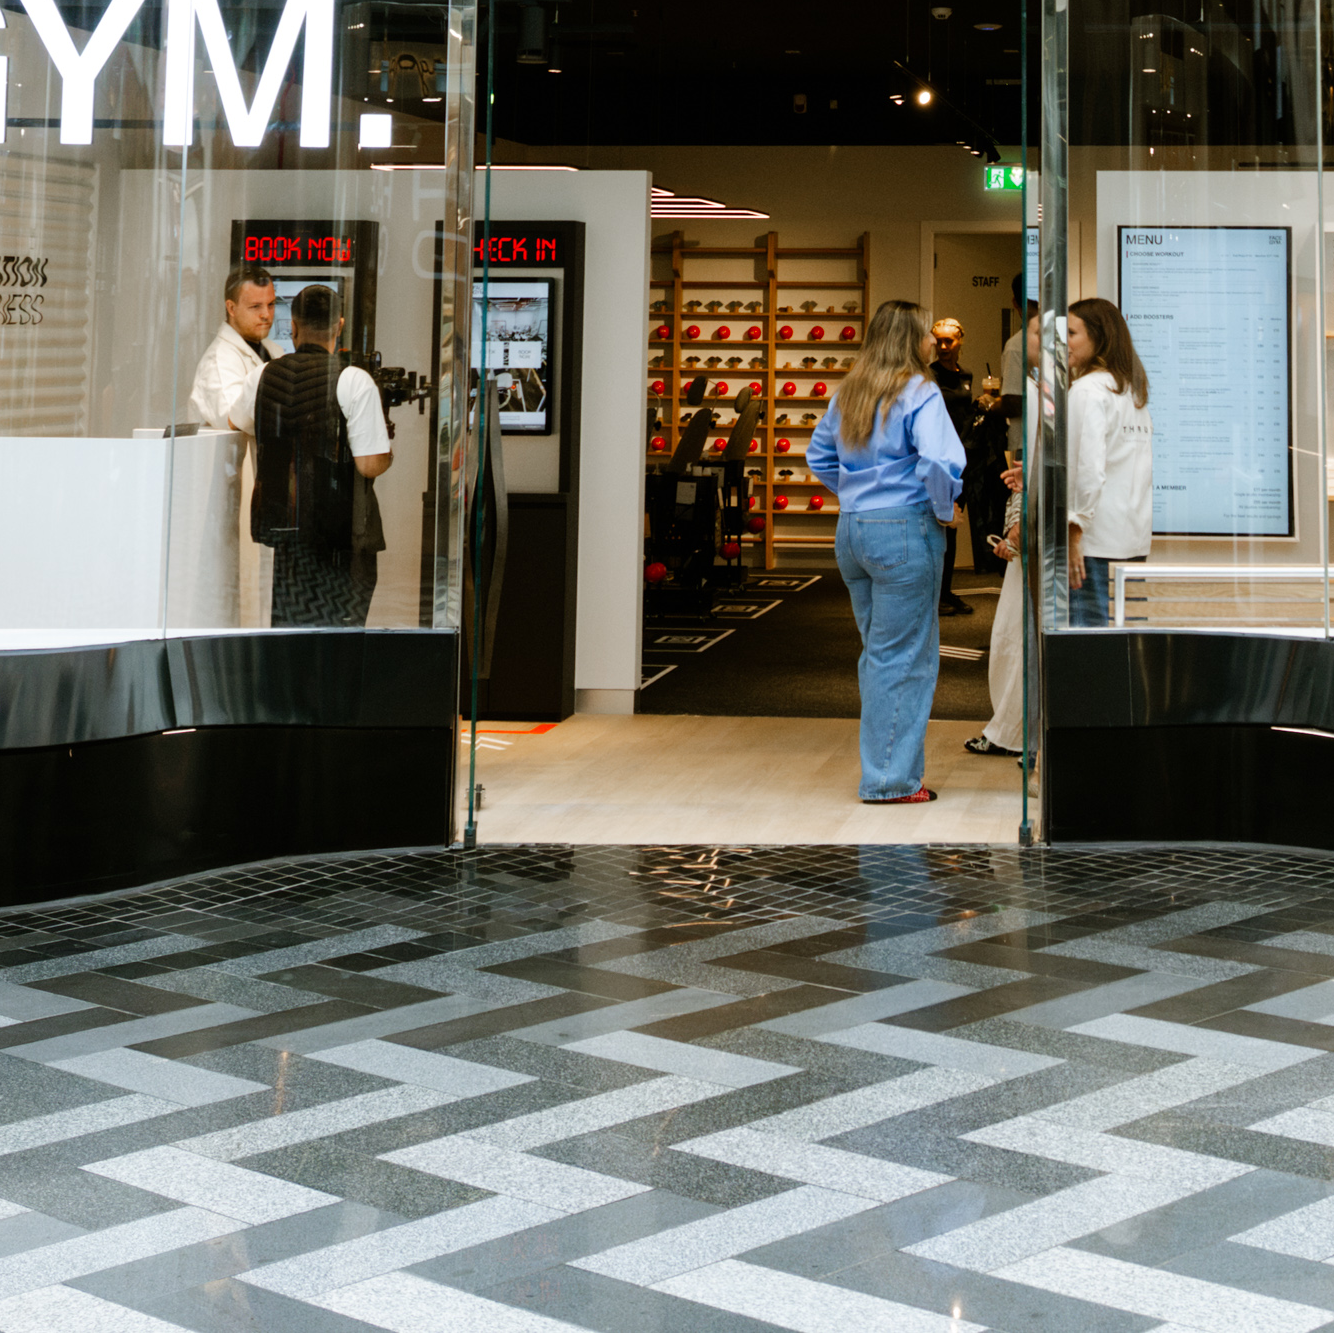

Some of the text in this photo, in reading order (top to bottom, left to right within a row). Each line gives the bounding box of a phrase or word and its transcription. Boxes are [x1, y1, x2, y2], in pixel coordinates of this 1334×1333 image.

[244, 236, 351, 262] BOOK NOW
[1126, 234, 1163, 245] MENU
[473, 237, 557, 263] HECK IN
[972, 276, 1000, 288] STAFF
